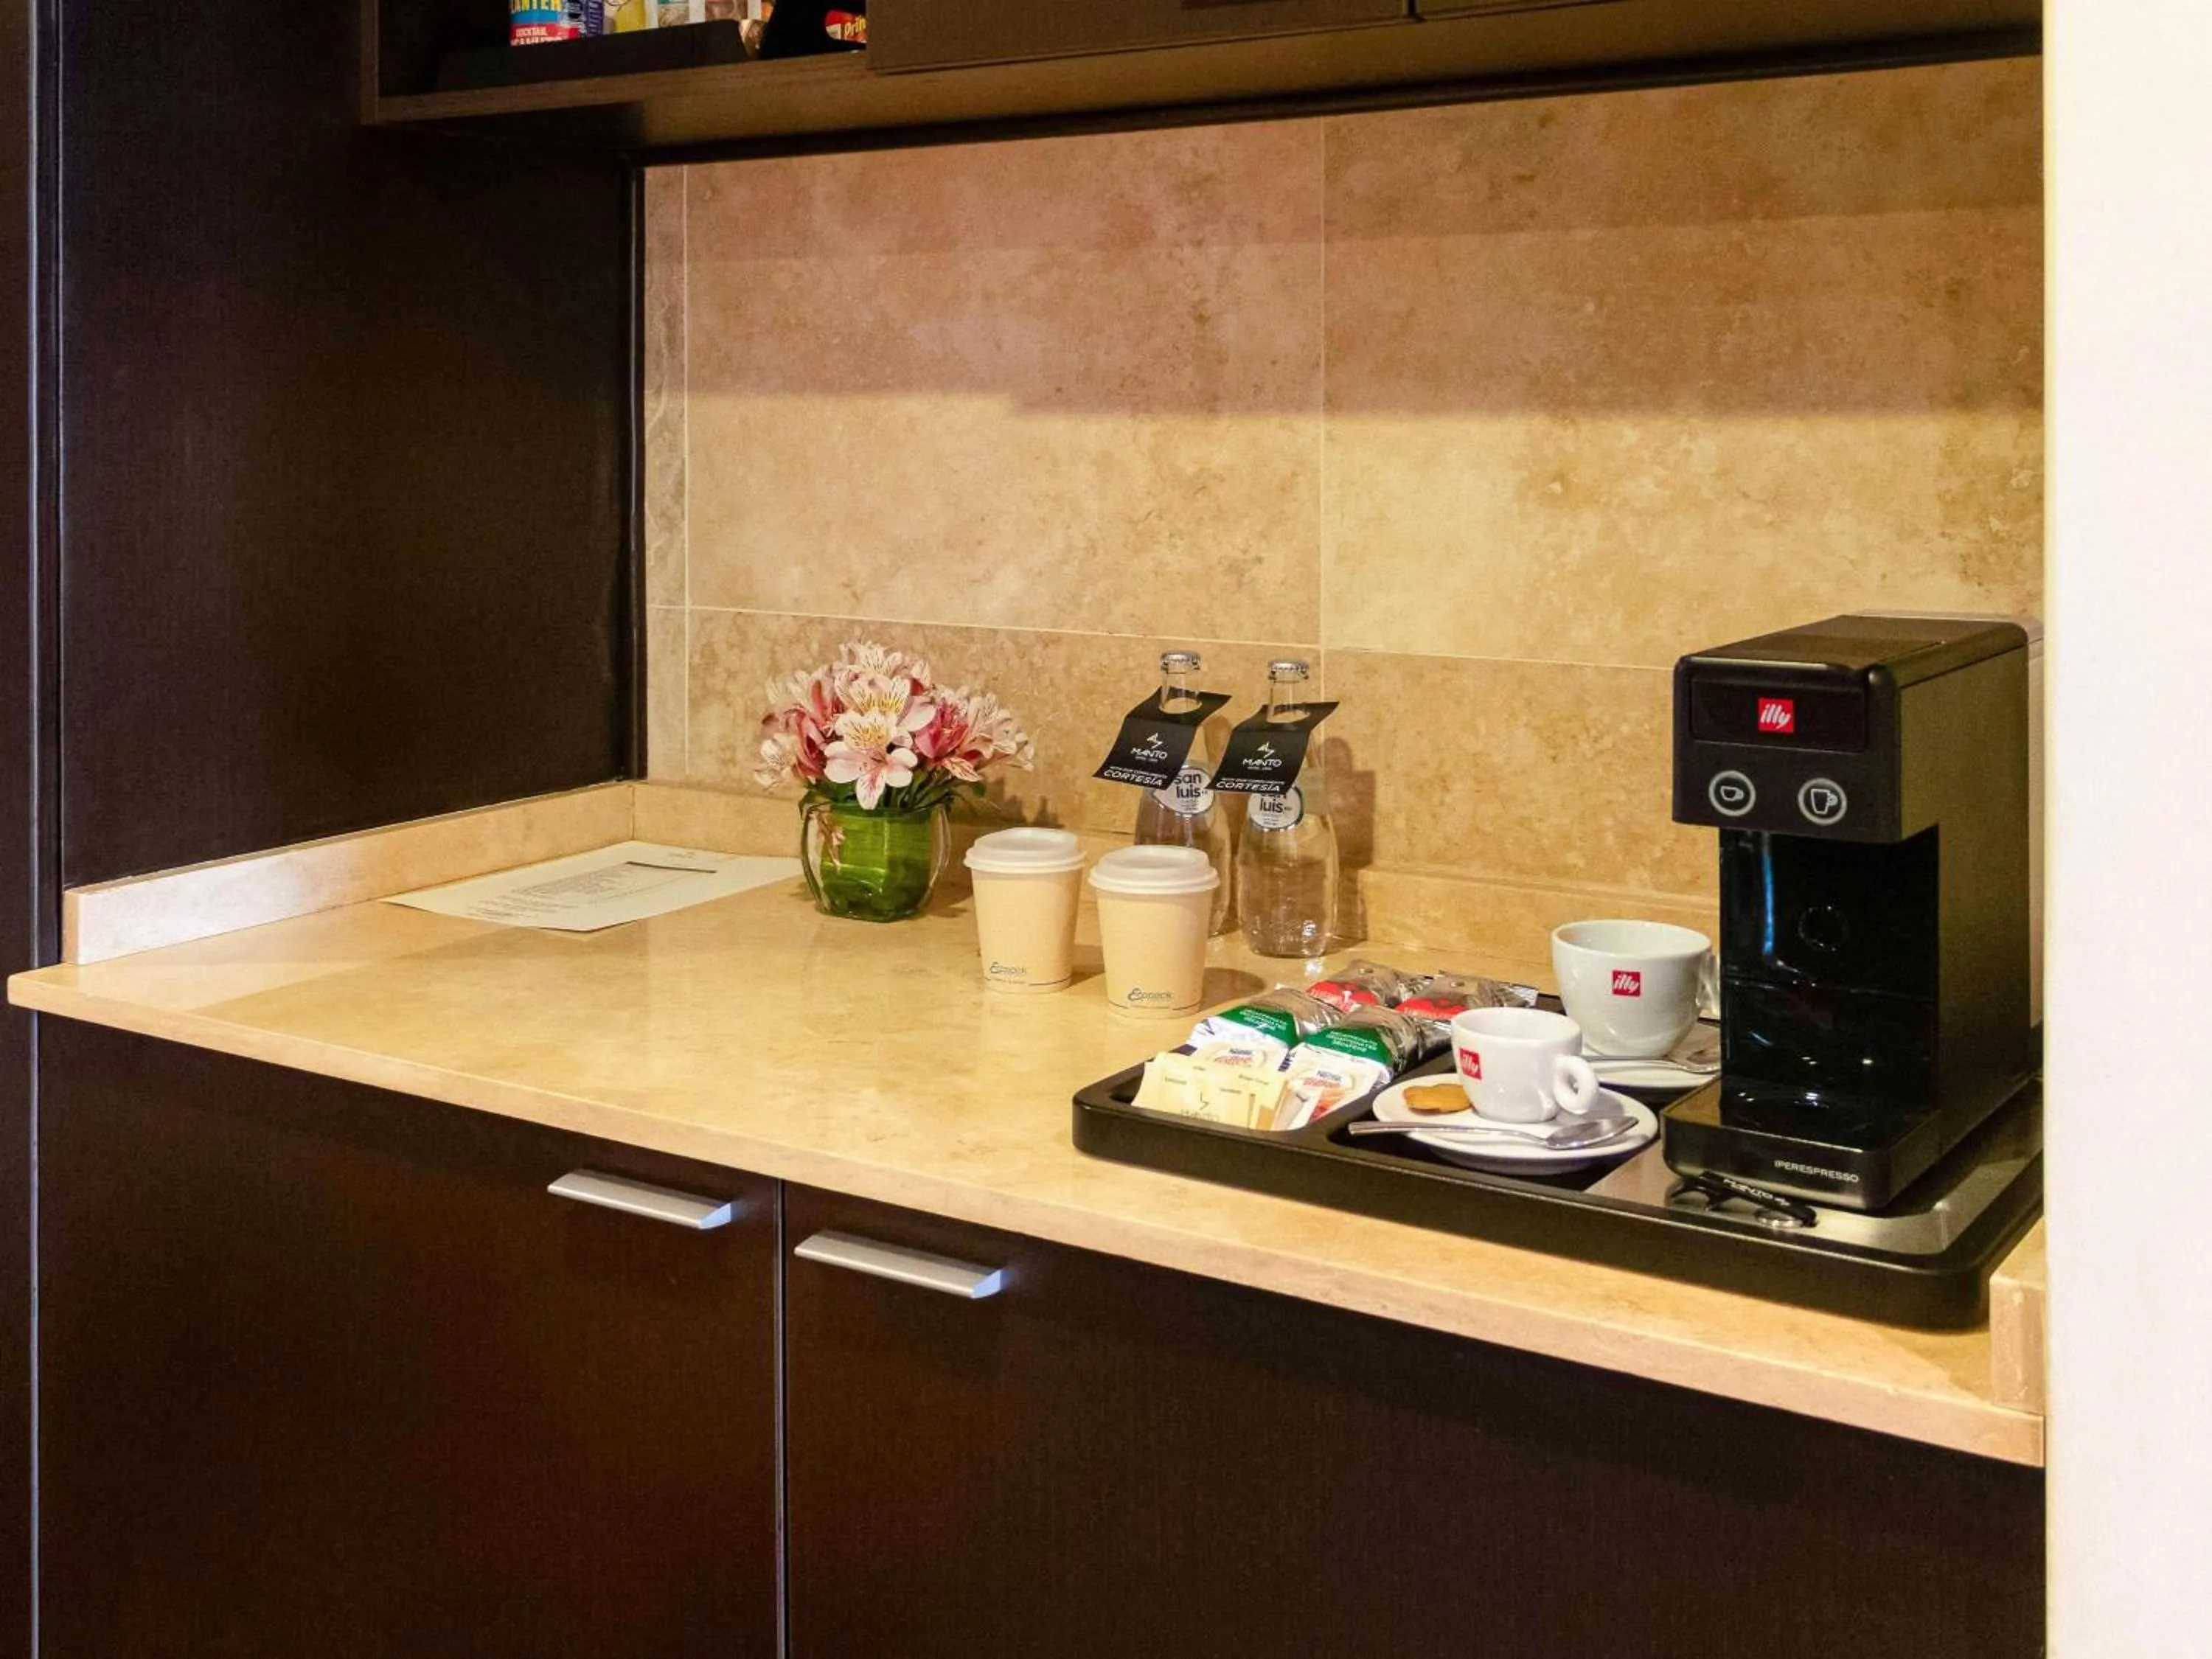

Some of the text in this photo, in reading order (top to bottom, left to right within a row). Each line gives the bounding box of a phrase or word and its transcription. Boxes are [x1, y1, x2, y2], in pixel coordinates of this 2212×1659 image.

[1760, 703, 1792, 730] illy
[1130, 746, 1168, 759] MANTO
[1242, 758, 1282, 768] MANTO
[1176, 784, 1202, 799] luis
[1215, 780, 1281, 792] CORTESÍA
[1259, 797, 1284, 813] luis
[1613, 974, 1640, 992] illy
[1462, 1053, 1479, 1073] illy
[1773, 1159, 1860, 1183] IPERESPRESSO
